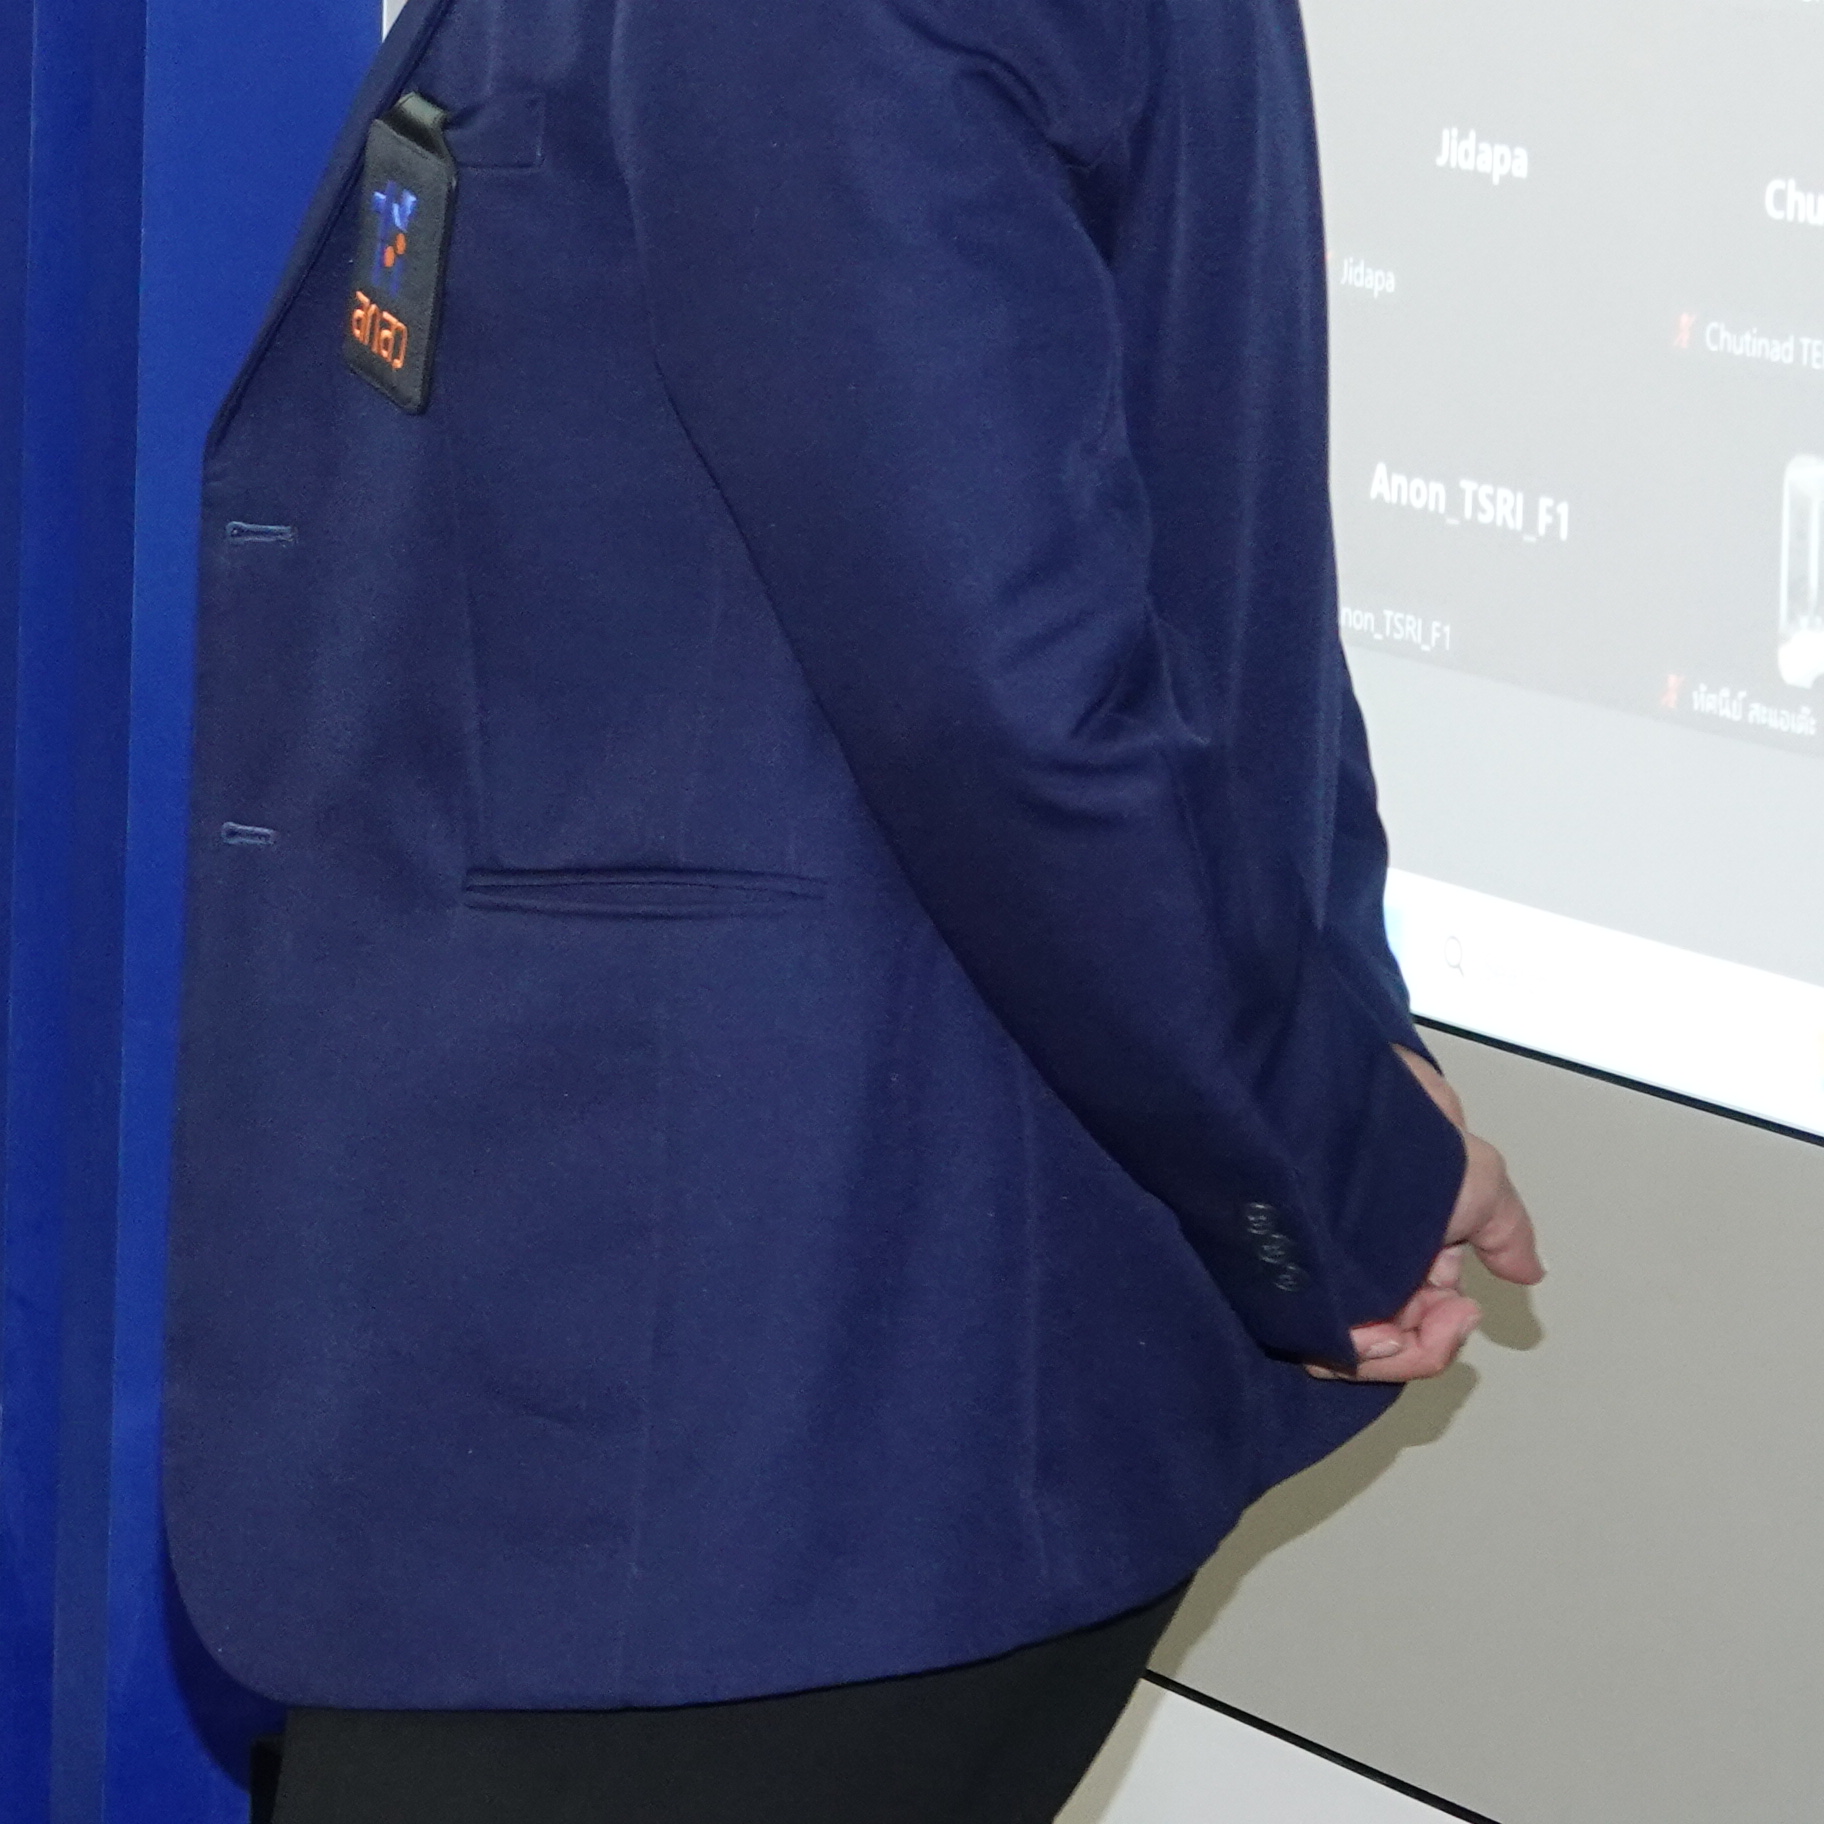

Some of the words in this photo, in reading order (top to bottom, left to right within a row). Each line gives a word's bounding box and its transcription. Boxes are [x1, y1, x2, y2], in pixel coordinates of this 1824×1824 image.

[1435, 127, 1529, 186] Jidapa
[1340, 256, 1396, 299] Jidapa
[1705, 321, 1795, 364] Chutinad
[1341, 606, 1451, 652] non_TSRI_F1
